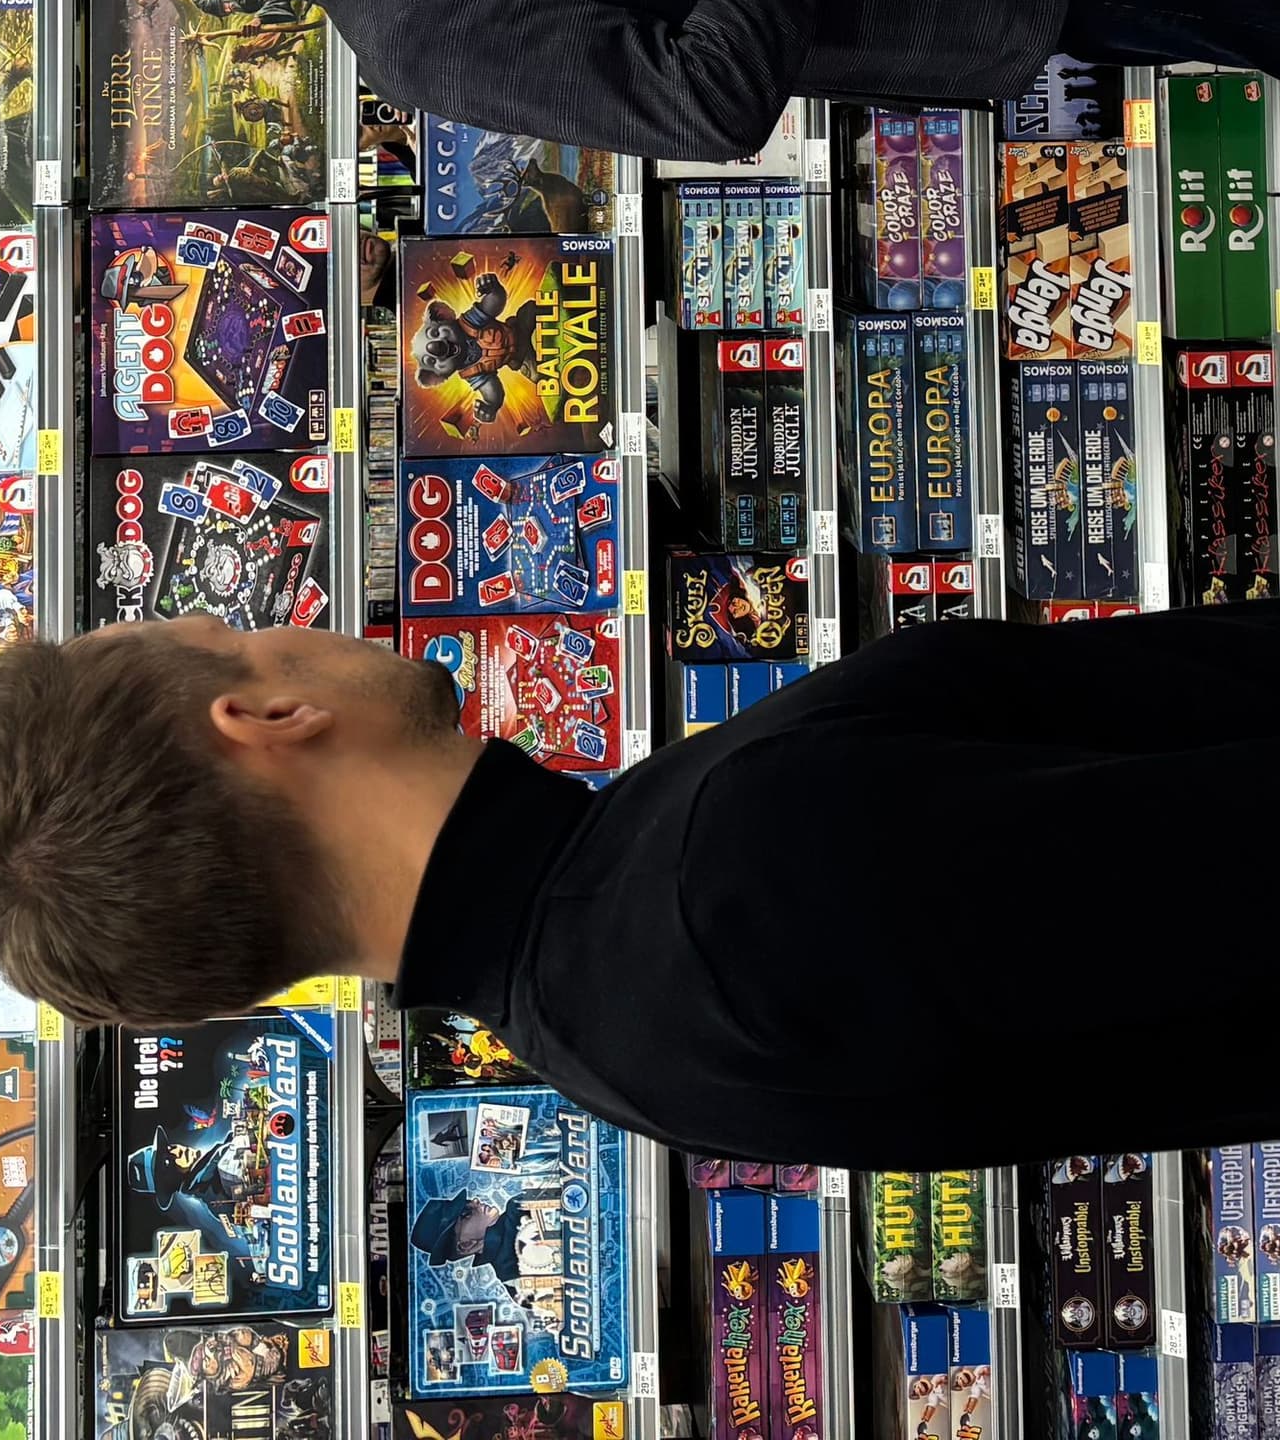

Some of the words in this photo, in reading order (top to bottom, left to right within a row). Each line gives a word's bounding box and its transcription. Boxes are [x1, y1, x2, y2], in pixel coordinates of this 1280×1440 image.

[110, 48, 135, 129] HERR
[143, 47, 163, 127] RINGE
[168, 106, 176, 150] GEMEINSAM
[437, 121, 456, 220] CASCA
[893, 171, 915, 227] CRAZE
[696, 220, 709, 269] TEAM
[738, 220, 750, 268] TEAM
[881, 189, 903, 243] COLOR
[1179, 169, 1215, 252] Rolit
[697, 272, 710, 308] SKY
[738, 271, 751, 306] SKY
[1009, 261, 1059, 352] Jenga
[114, 309, 149, 421] AGENT
[141, 303, 176, 404] DOG
[536, 290, 560, 396] BATTLE
[561, 261, 598, 422] ROYALE
[730, 408, 743, 476] FORBIDDEN
[742, 405, 758, 479] JUNGLE
[773, 406, 785, 475] FORBIDDEN
[867, 369, 895, 502] EUROPA
[925, 365, 953, 498] EUROPA
[1029, 432, 1045, 462] ERDE
[118, 469, 144, 543] DOG
[1030, 465, 1046, 485] DIE
[1031, 488, 1047, 507] UM
[1032, 511, 1048, 545] REISE
[675, 568, 717, 648] SKULL
[750, 565, 790, 648] QUEEN
[134, 1037, 158, 1074] drei
[160, 1038, 183, 1072] ???
[268, 1039, 297, 1110] Yard
[134, 1079, 159, 1108] Die
[559, 1112, 590, 1185] Yard
[1221, 1145, 1244, 1221] VENTOPIA
[268, 1142, 299, 1286] Scotland
[1077, 1202, 1093, 1273] Unstoppable!
[561, 1217, 592, 1358] Scotland
[720, 1304, 761, 1427] Kakerlahex
